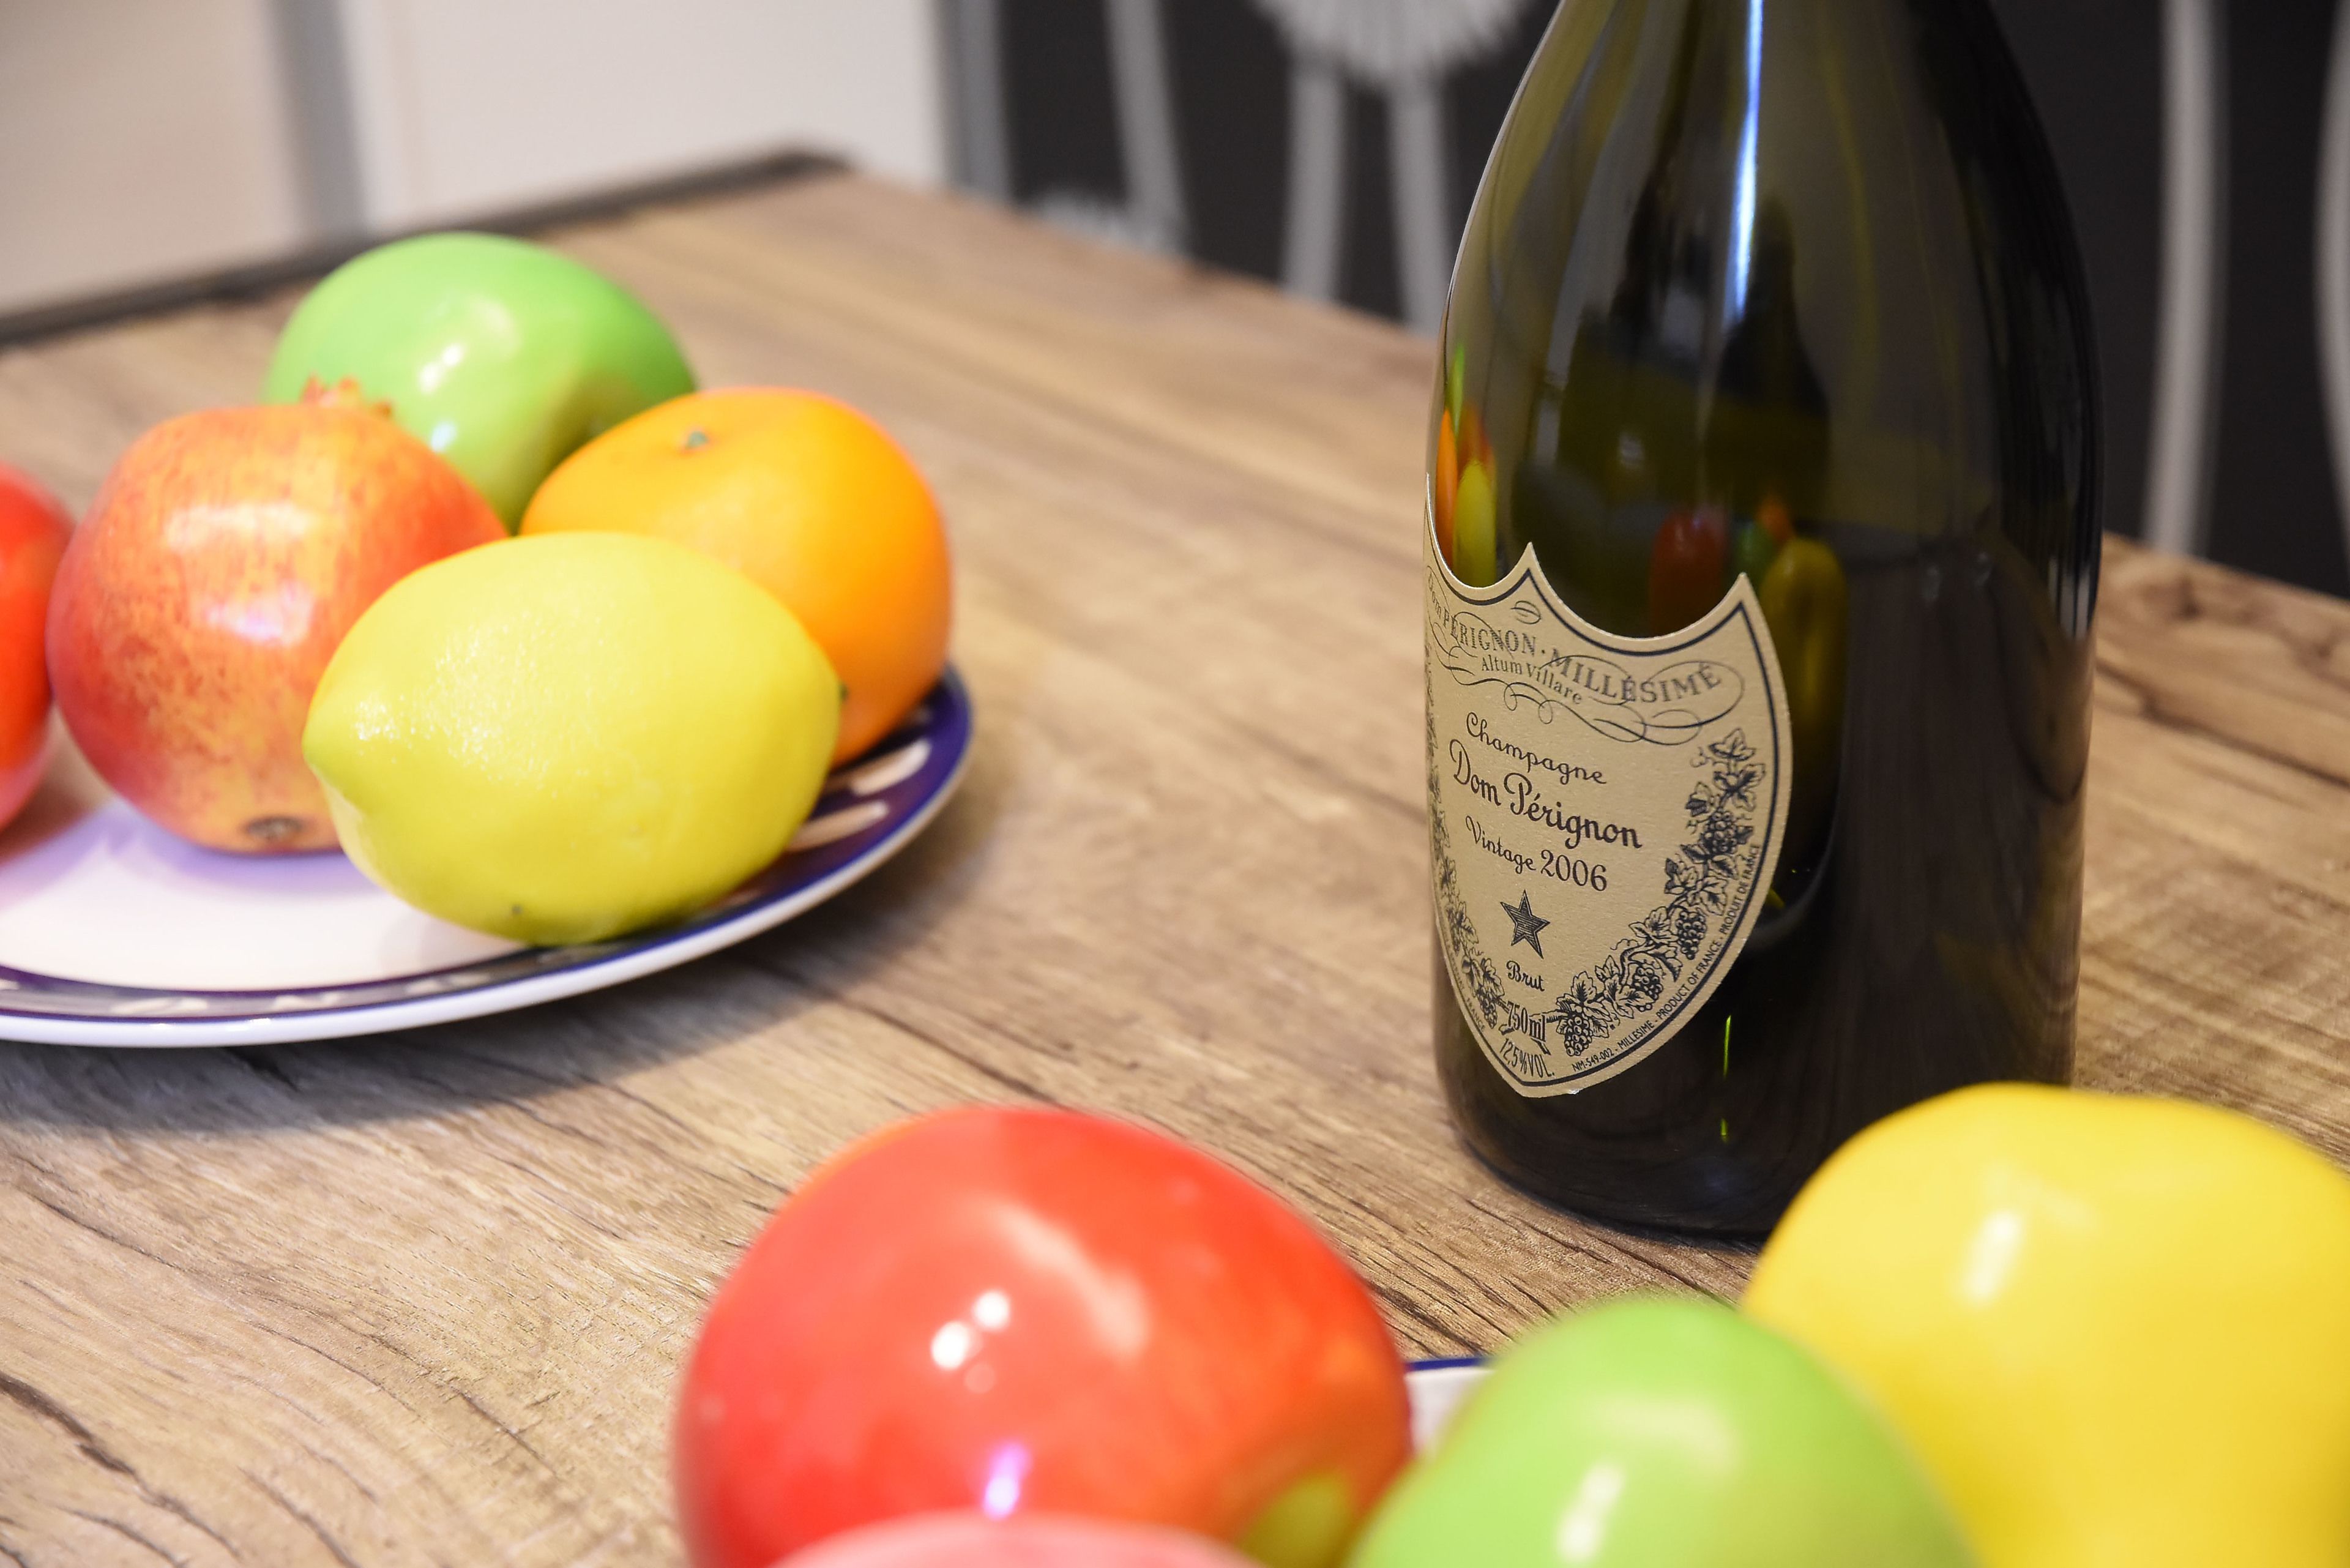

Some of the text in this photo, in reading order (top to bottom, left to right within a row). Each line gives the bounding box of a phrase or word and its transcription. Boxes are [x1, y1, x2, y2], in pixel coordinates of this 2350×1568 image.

[1481, 654, 1523, 675] Altum
[1466, 711, 1608, 785] Champagne
[1449, 739, 1643, 849] Dom Pérignon
[1465, 815, 1608, 892] Vintage 2006
[1505, 960, 1545, 991] Brut
[1571, 1047, 1615, 1072] NM-549-002
[1617, 1020, 1655, 1050] MILLESIME
[1656, 984, 1692, 1020] PRODUCT
[1687, 972, 1699, 985] OF
[1696, 939, 1722, 974] FRANCE
[1718, 897, 1744, 935] PRODUIT
[1736, 880, 1749, 895] DE
[1507, 1000, 1546, 1043] 750ml
